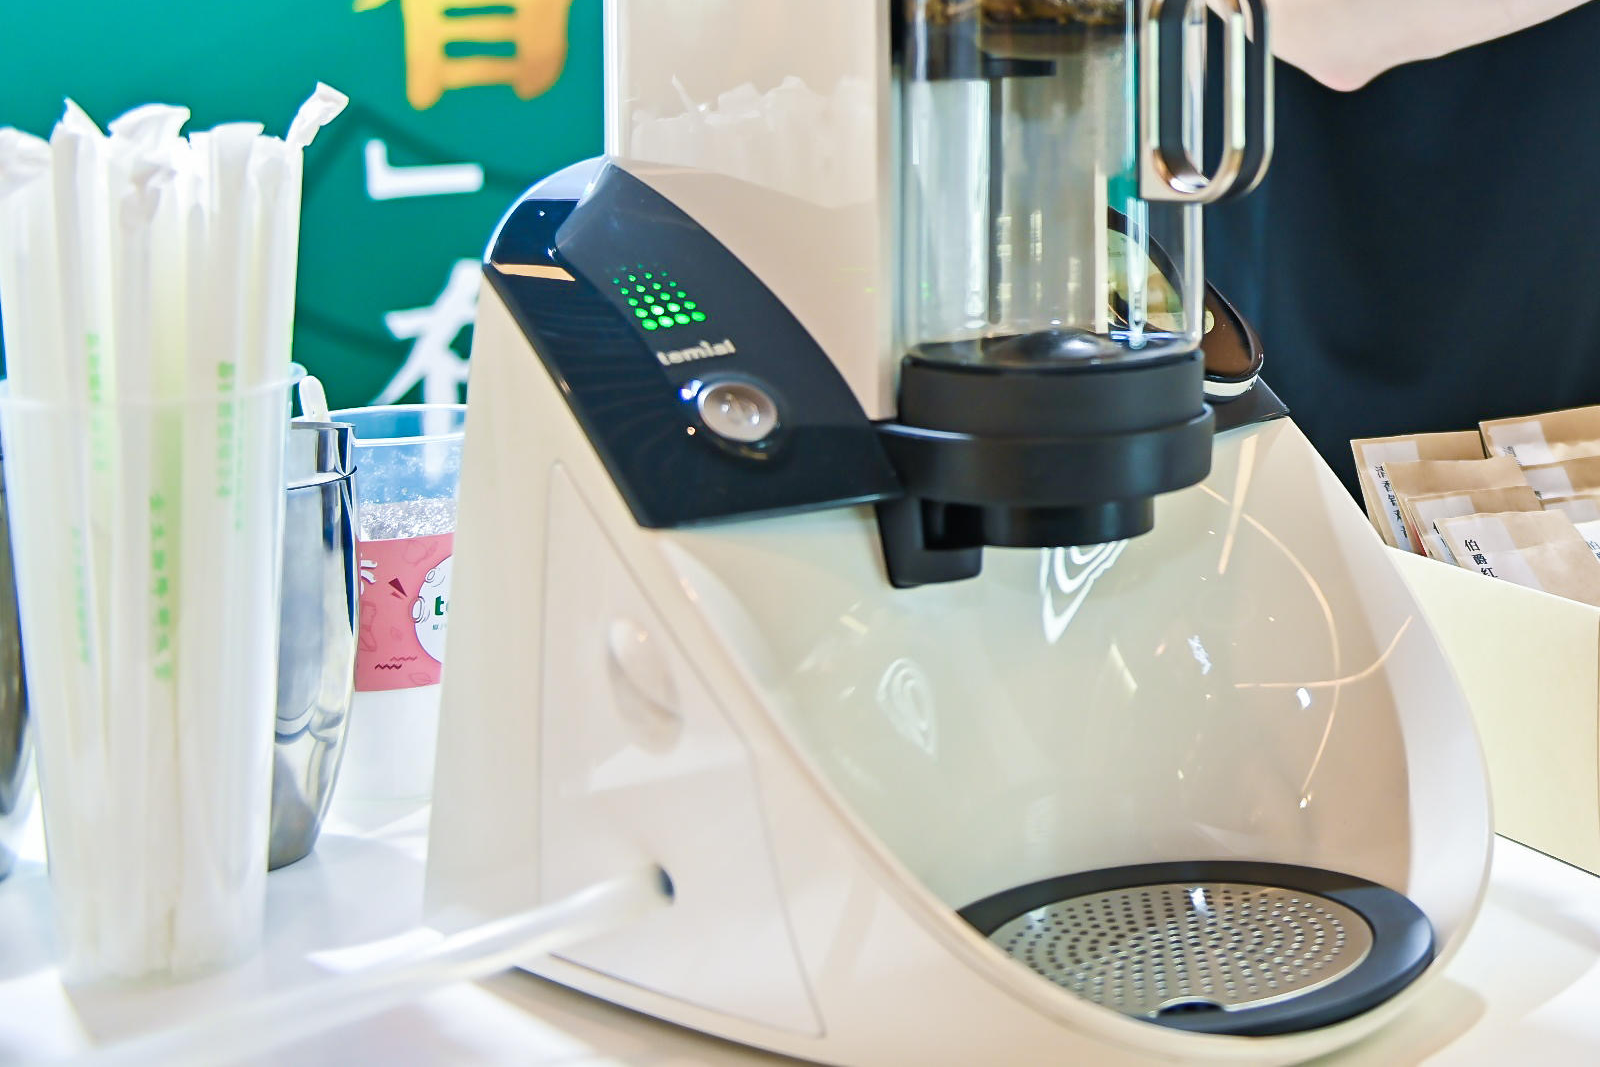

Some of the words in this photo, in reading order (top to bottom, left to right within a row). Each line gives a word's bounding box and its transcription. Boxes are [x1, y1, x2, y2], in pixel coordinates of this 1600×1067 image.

[656, 338, 737, 366] temial
[1464, 539, 1499, 578] 伯爵红
